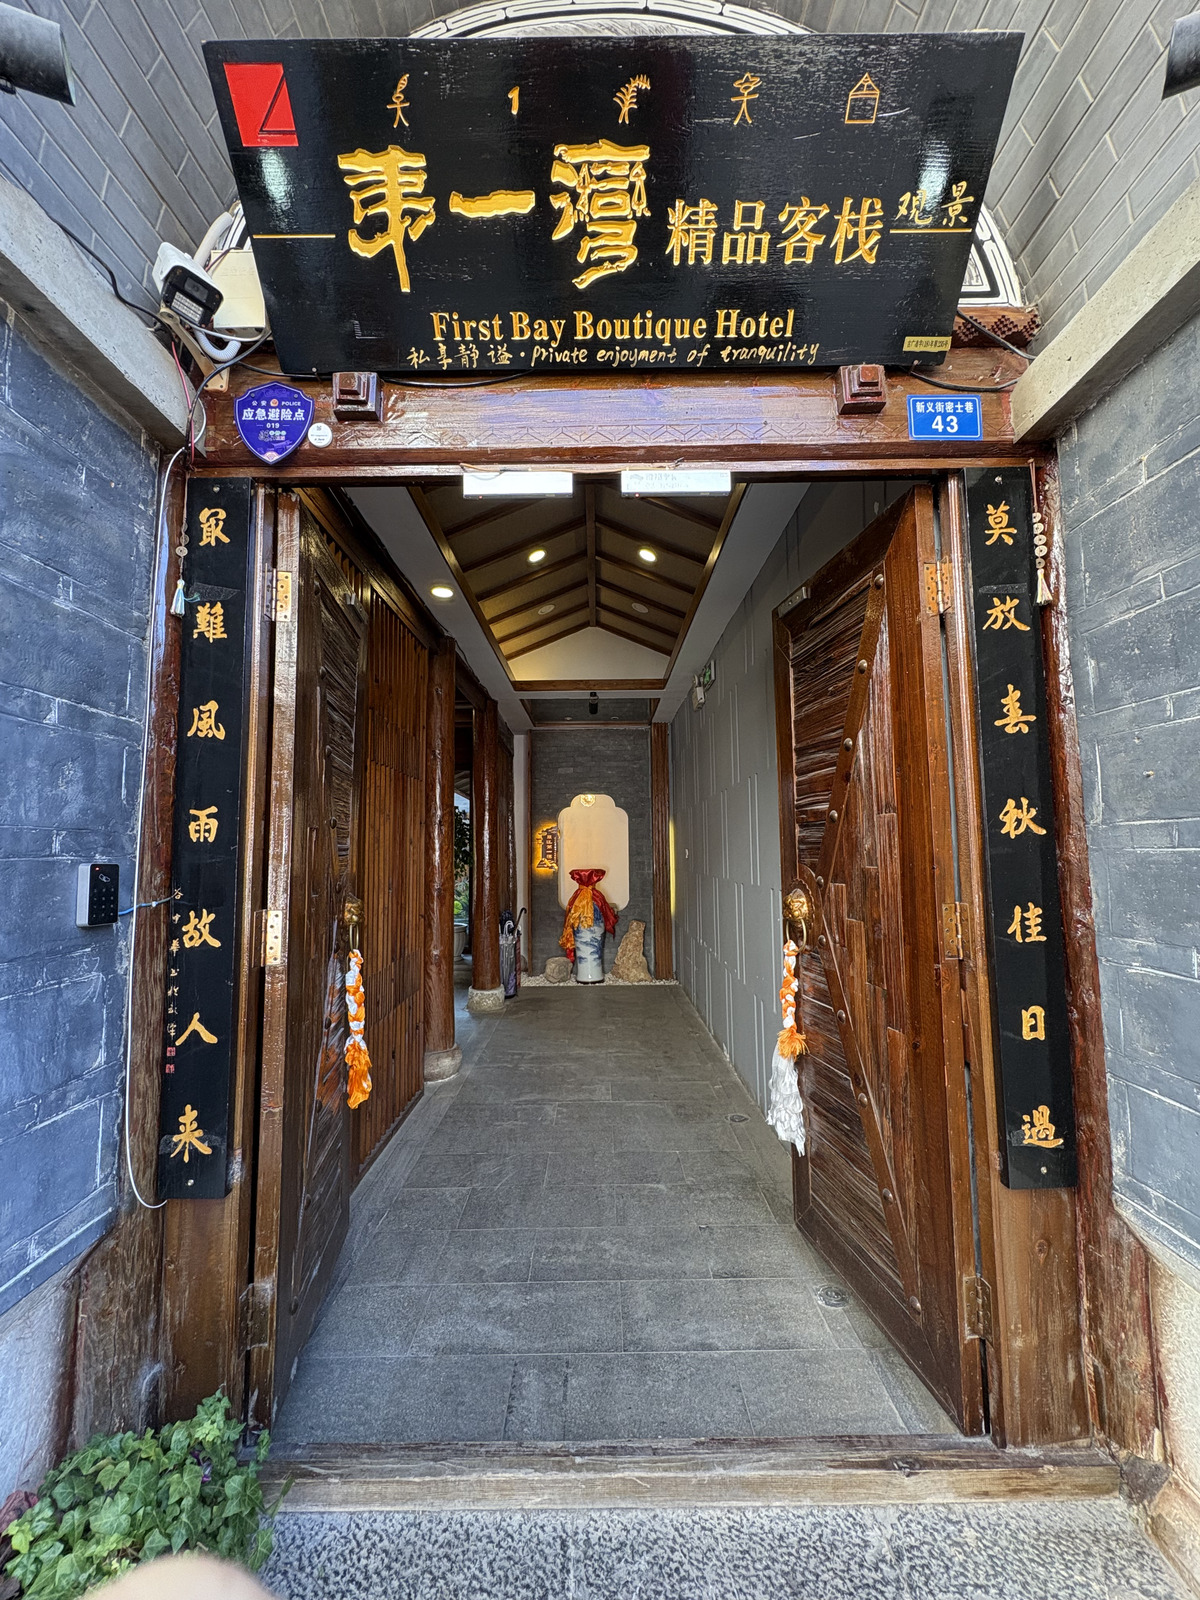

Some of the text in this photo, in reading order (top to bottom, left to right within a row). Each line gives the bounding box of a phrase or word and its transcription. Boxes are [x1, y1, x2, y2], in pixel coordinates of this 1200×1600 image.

[894, 180, 975, 226] 观景
[665, 195, 884, 266] 精品客栈
[430, 308, 795, 347] First Bay Boutique Hotel
[596, 345, 677, 367] enjoyment
[687, 343, 711, 367] of
[720, 341, 820, 365] tranquility
[242, 408, 305, 421] 应急避险点
[915, 401, 974, 413] 新义街密士巷
[931, 415, 958, 433] 43
